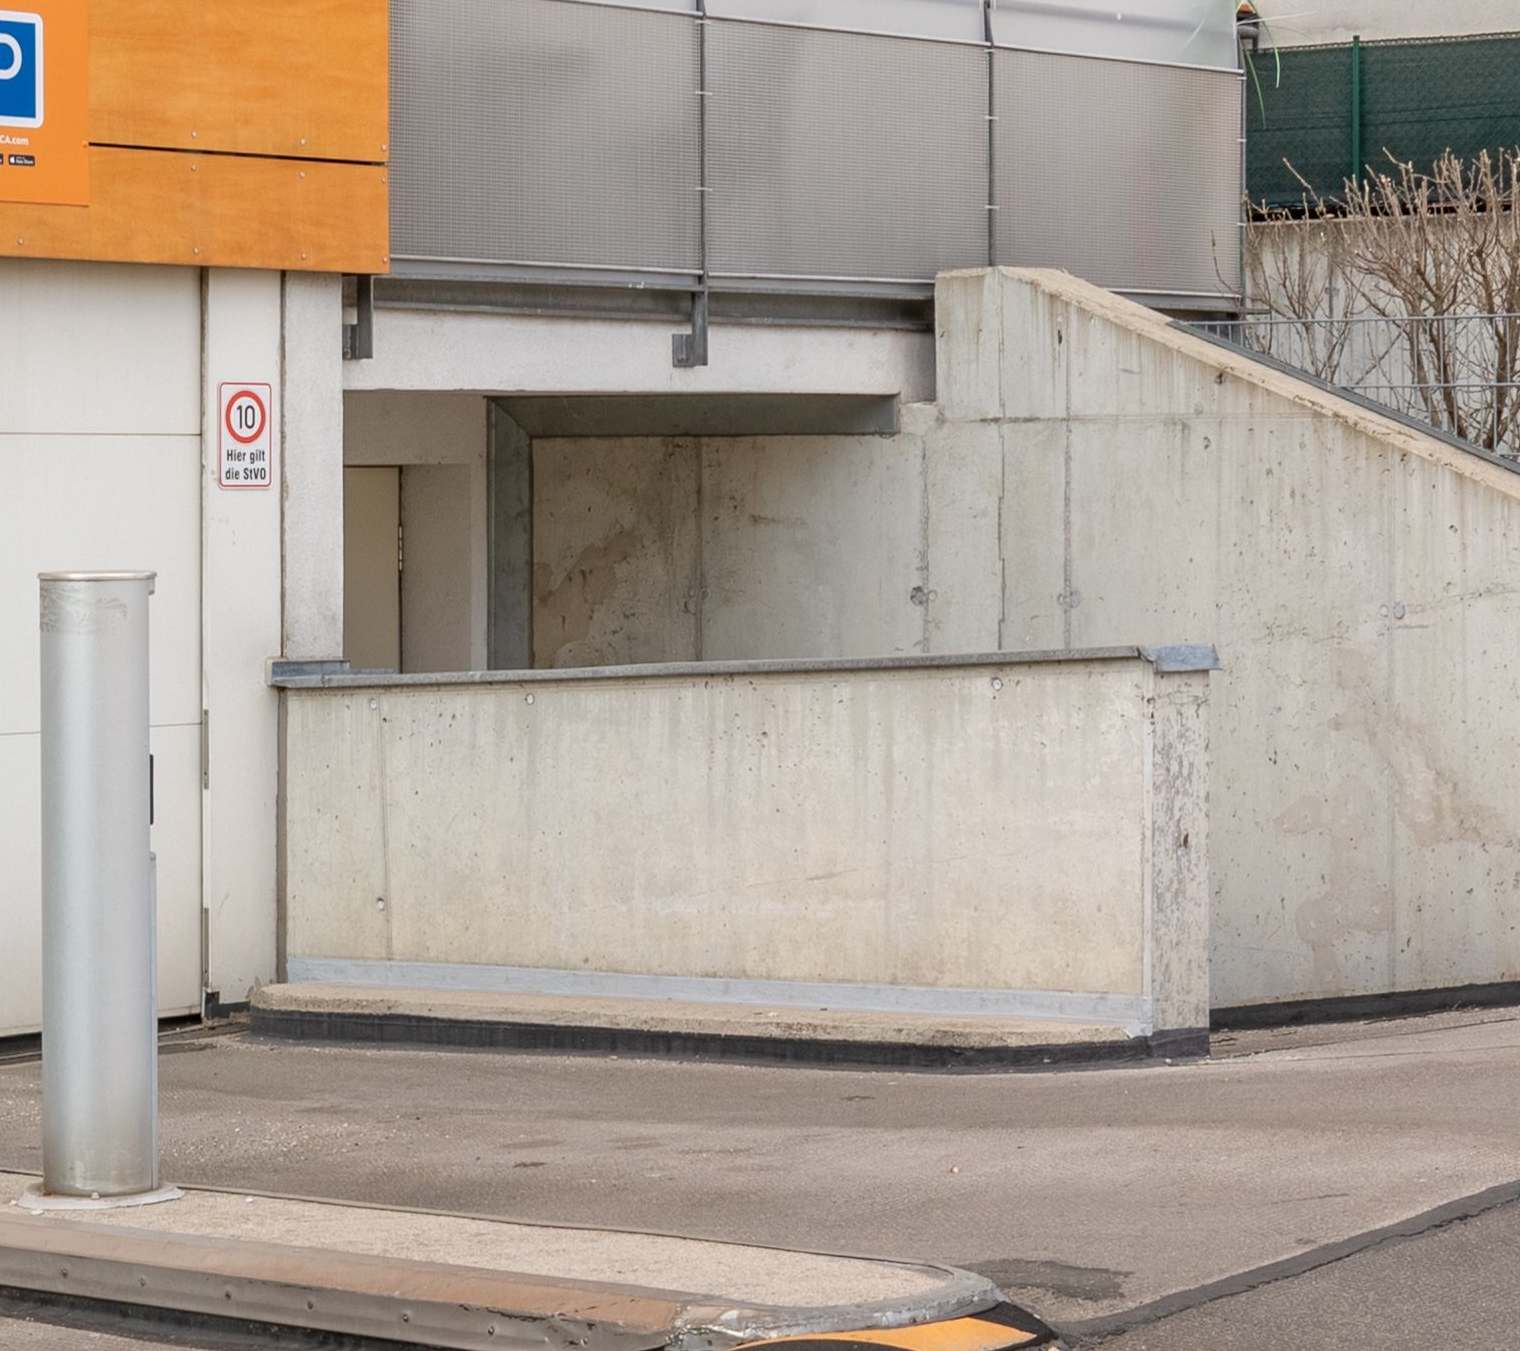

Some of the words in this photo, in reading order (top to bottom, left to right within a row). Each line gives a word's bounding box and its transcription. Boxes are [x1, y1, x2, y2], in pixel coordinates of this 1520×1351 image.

[236, 405, 256, 429] 10
[226, 449, 246, 462] Hier
[250, 449, 265, 464] gilt
[225, 467, 240, 480] die
[243, 467, 266, 480] StVO
